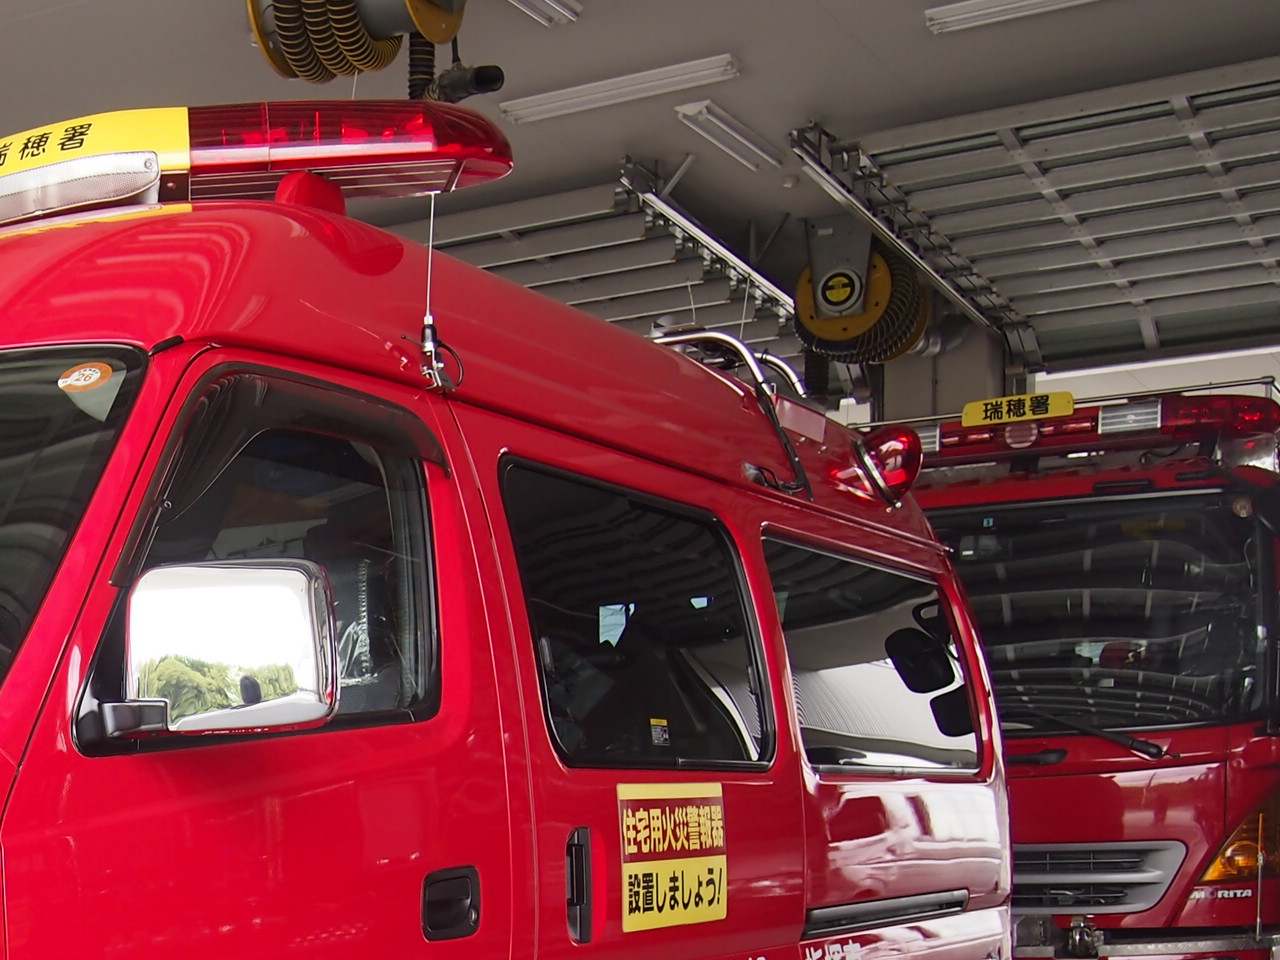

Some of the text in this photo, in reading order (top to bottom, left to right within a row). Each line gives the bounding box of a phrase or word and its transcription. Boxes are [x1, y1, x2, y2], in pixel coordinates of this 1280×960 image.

[74, 373, 95, 382] 26
[982, 395, 1051, 421] 瑞穂署
[623, 805, 724, 855] 住宅用火災警報器
[628, 867, 723, 916] 設置しましょう!
[1189, 887, 1252, 899] MORITA
